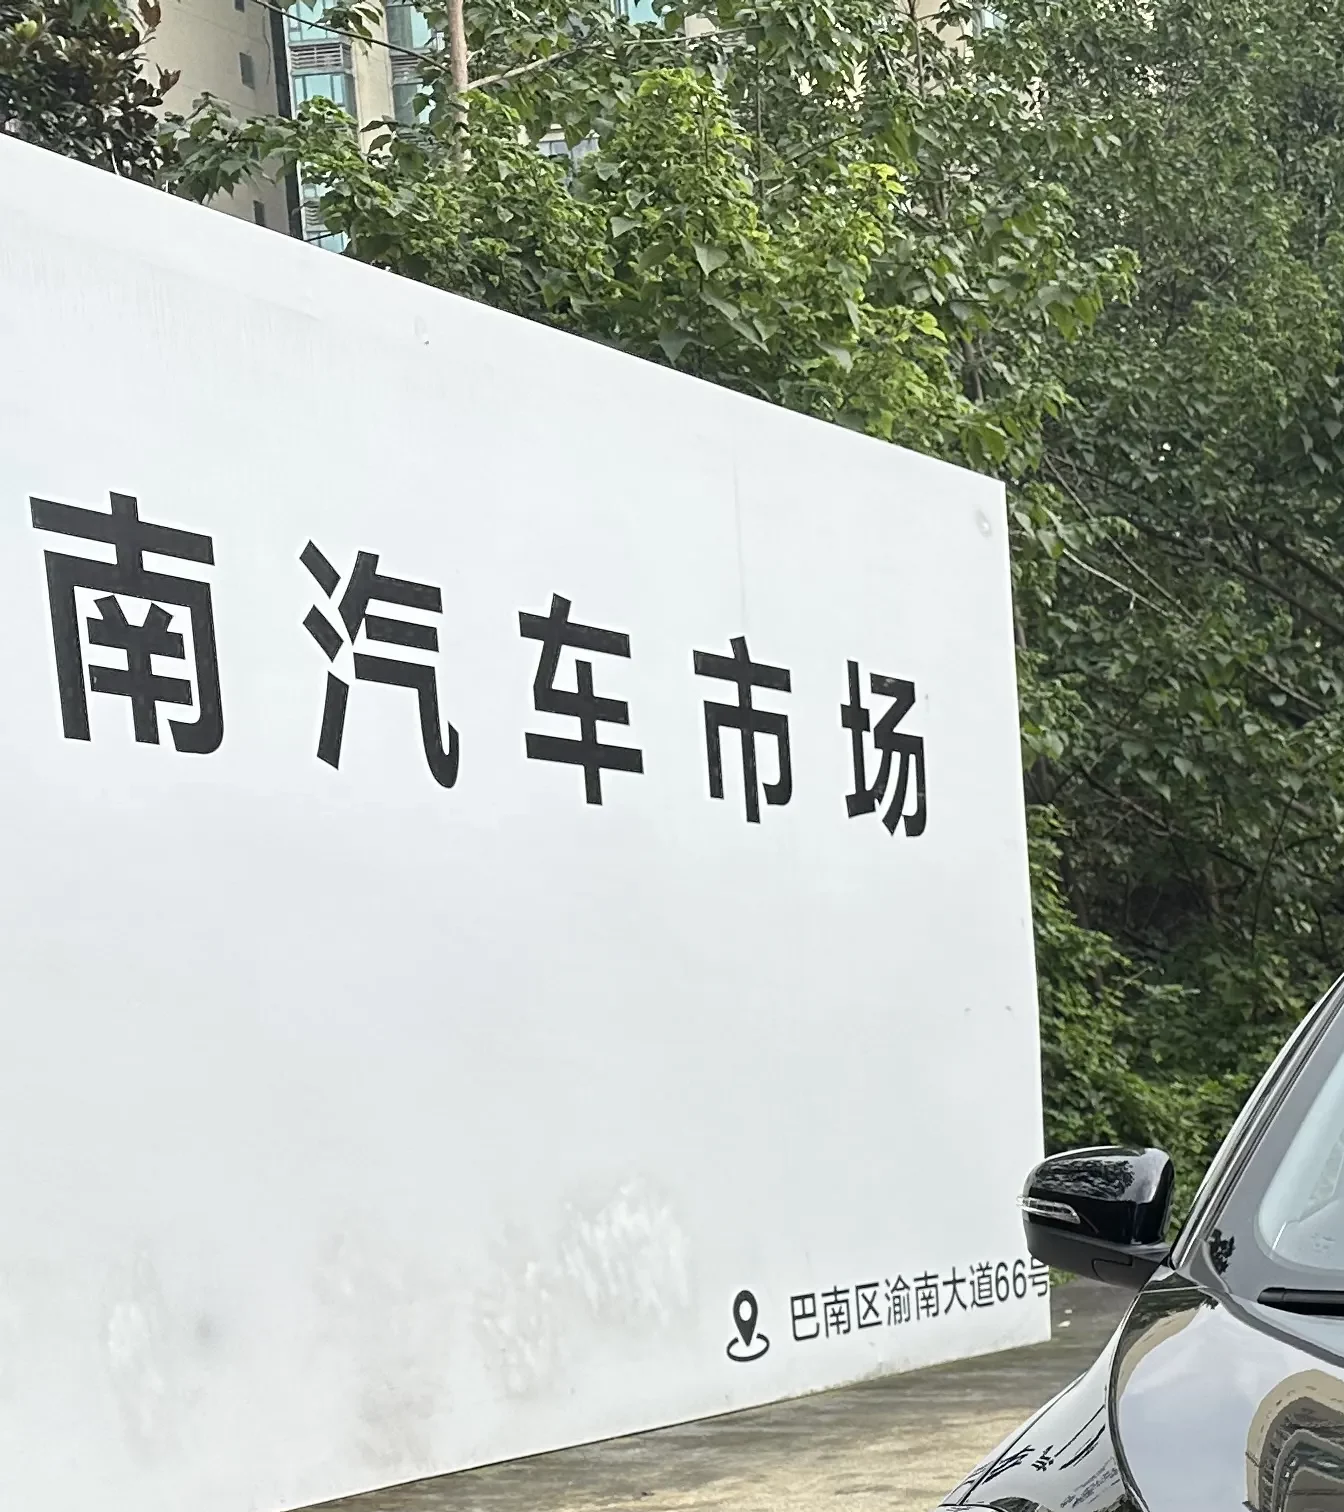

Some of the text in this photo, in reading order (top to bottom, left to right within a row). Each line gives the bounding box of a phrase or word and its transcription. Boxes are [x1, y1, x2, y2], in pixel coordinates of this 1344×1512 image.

[30, 491, 928, 837] 南汽车市场
[790, 1257, 1049, 1342] 巴南区渝南大道66号
